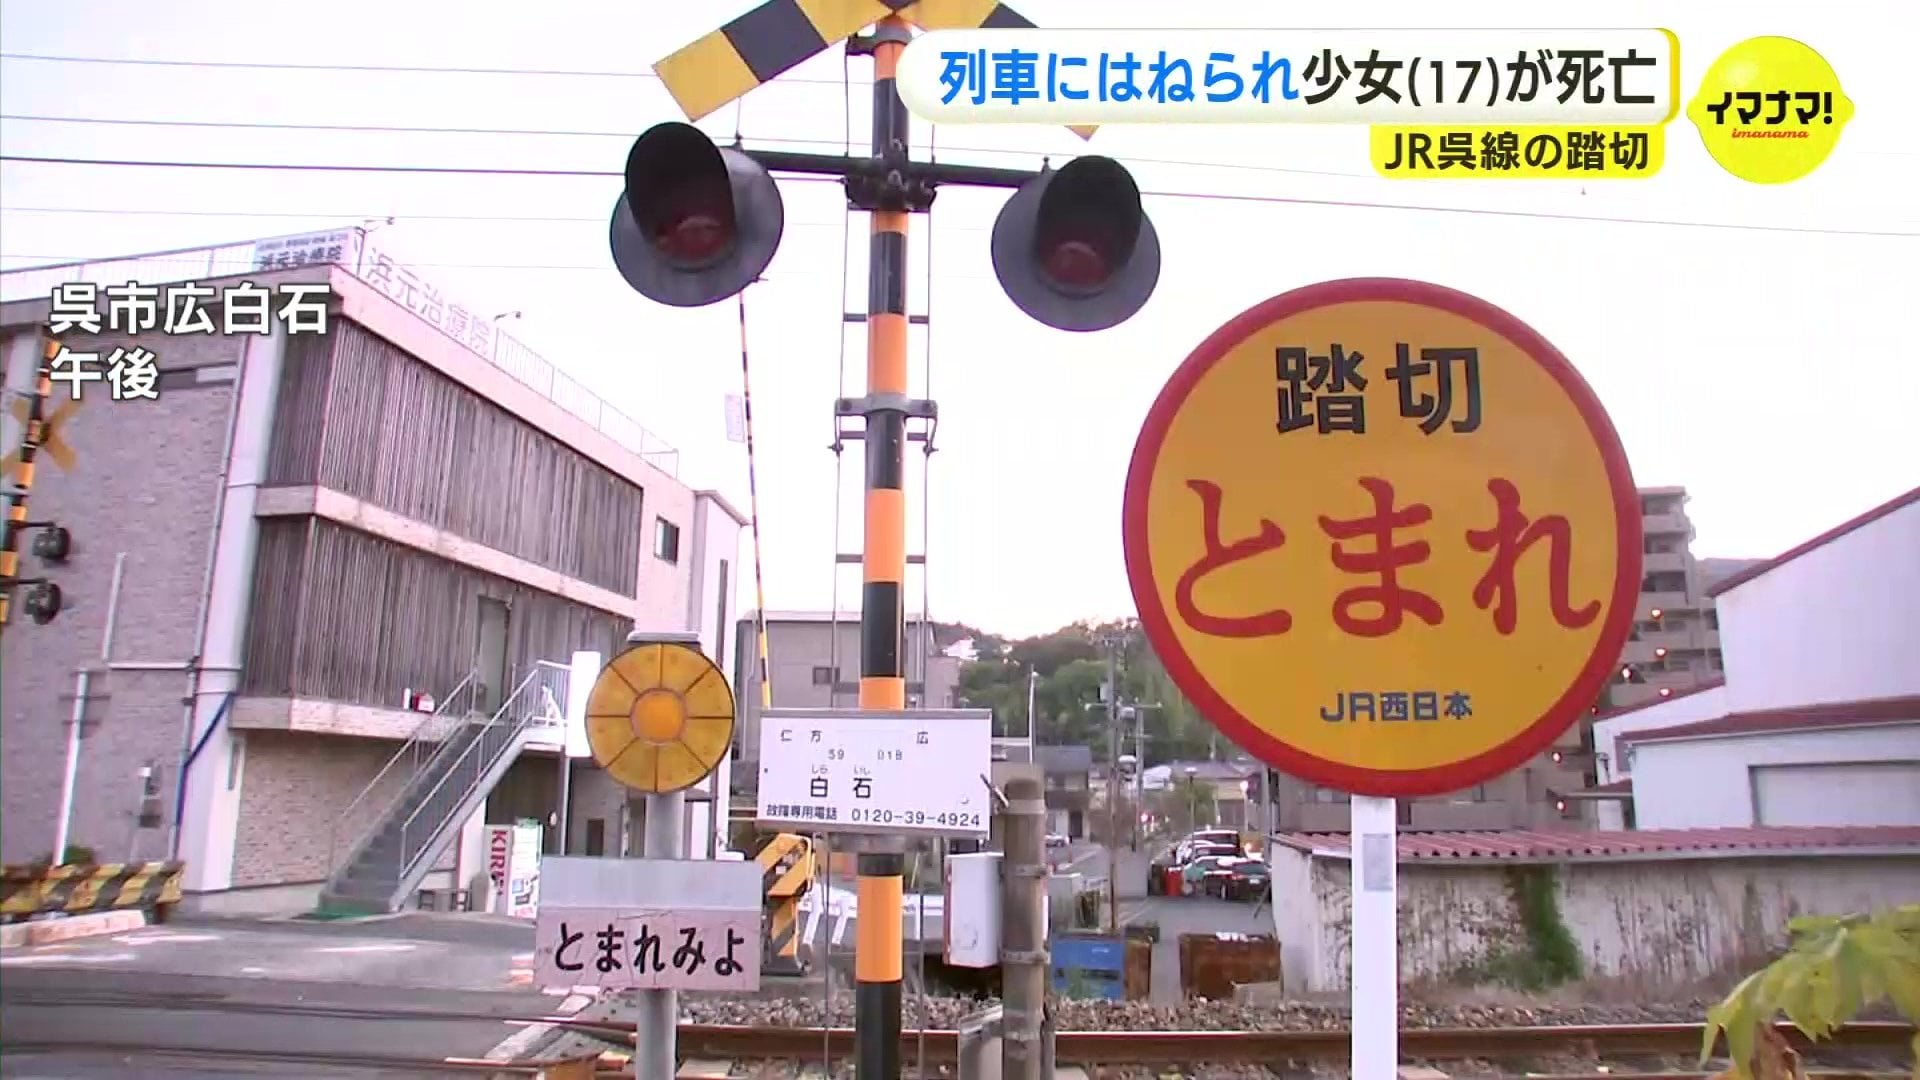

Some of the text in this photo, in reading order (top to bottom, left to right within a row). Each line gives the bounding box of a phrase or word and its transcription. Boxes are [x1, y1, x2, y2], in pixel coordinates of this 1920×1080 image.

[1275, 343, 1483, 436] 踏切
[1175, 476, 1602, 638] とまれ
[1319, 691, 1474, 723] JR西日本
[766, 804, 981, 827] 故障専用電話 0120-39-4924
[555, 922, 745, 976] とまれみよ
